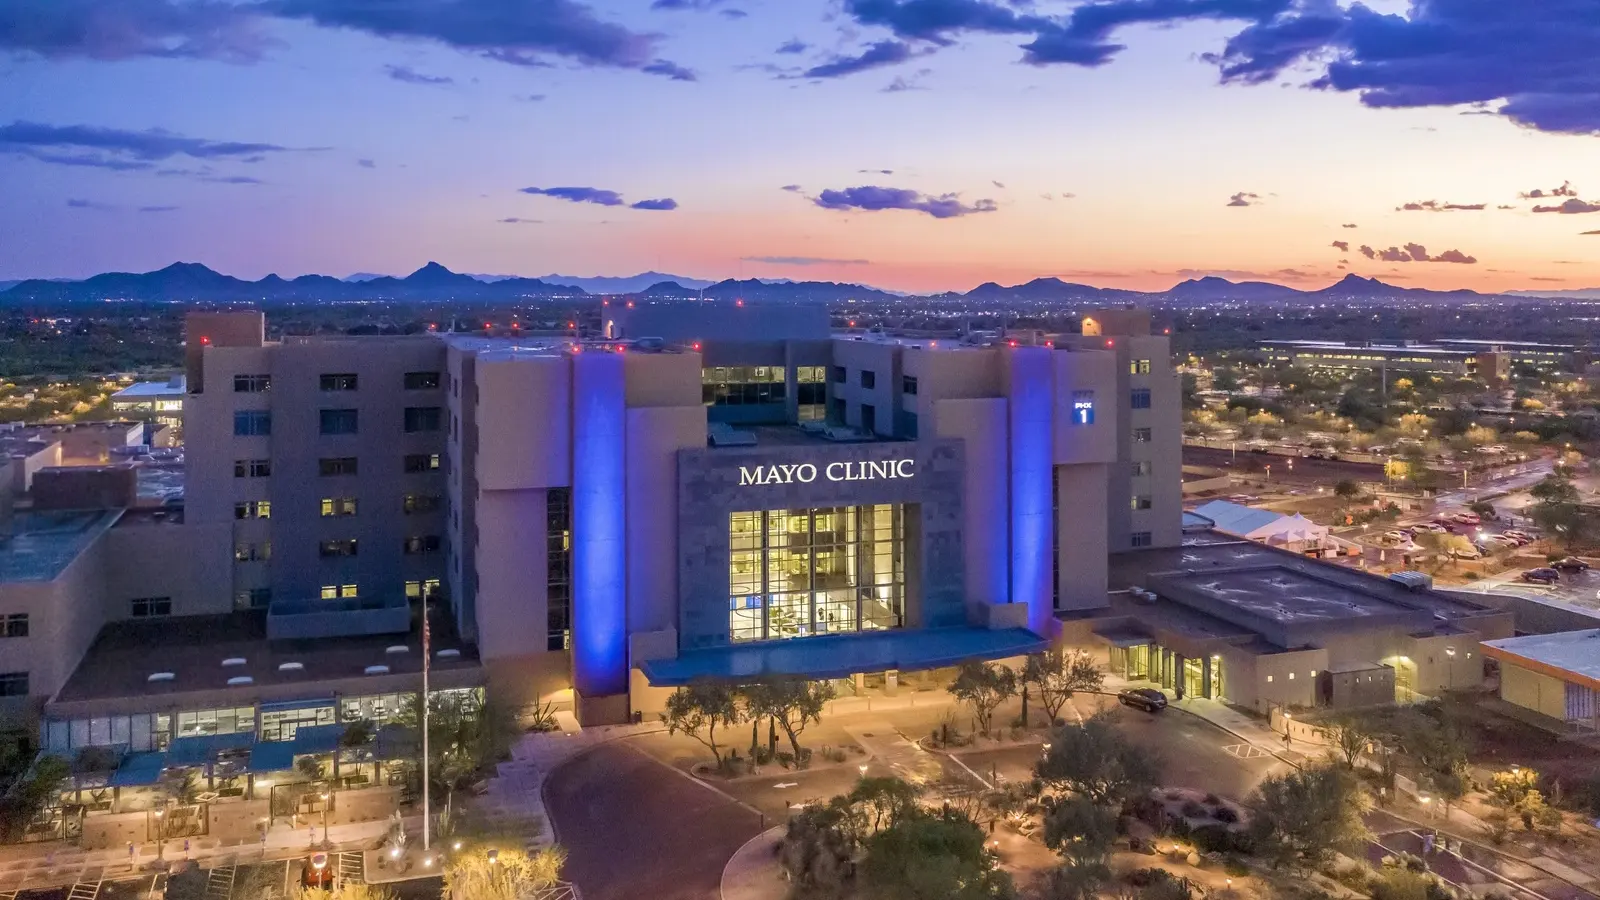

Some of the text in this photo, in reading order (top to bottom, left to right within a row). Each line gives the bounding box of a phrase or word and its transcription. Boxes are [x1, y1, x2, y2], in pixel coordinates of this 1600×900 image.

[1080, 409, 1087, 423] 1
[739, 459, 914, 486] MAYO CLINIC
